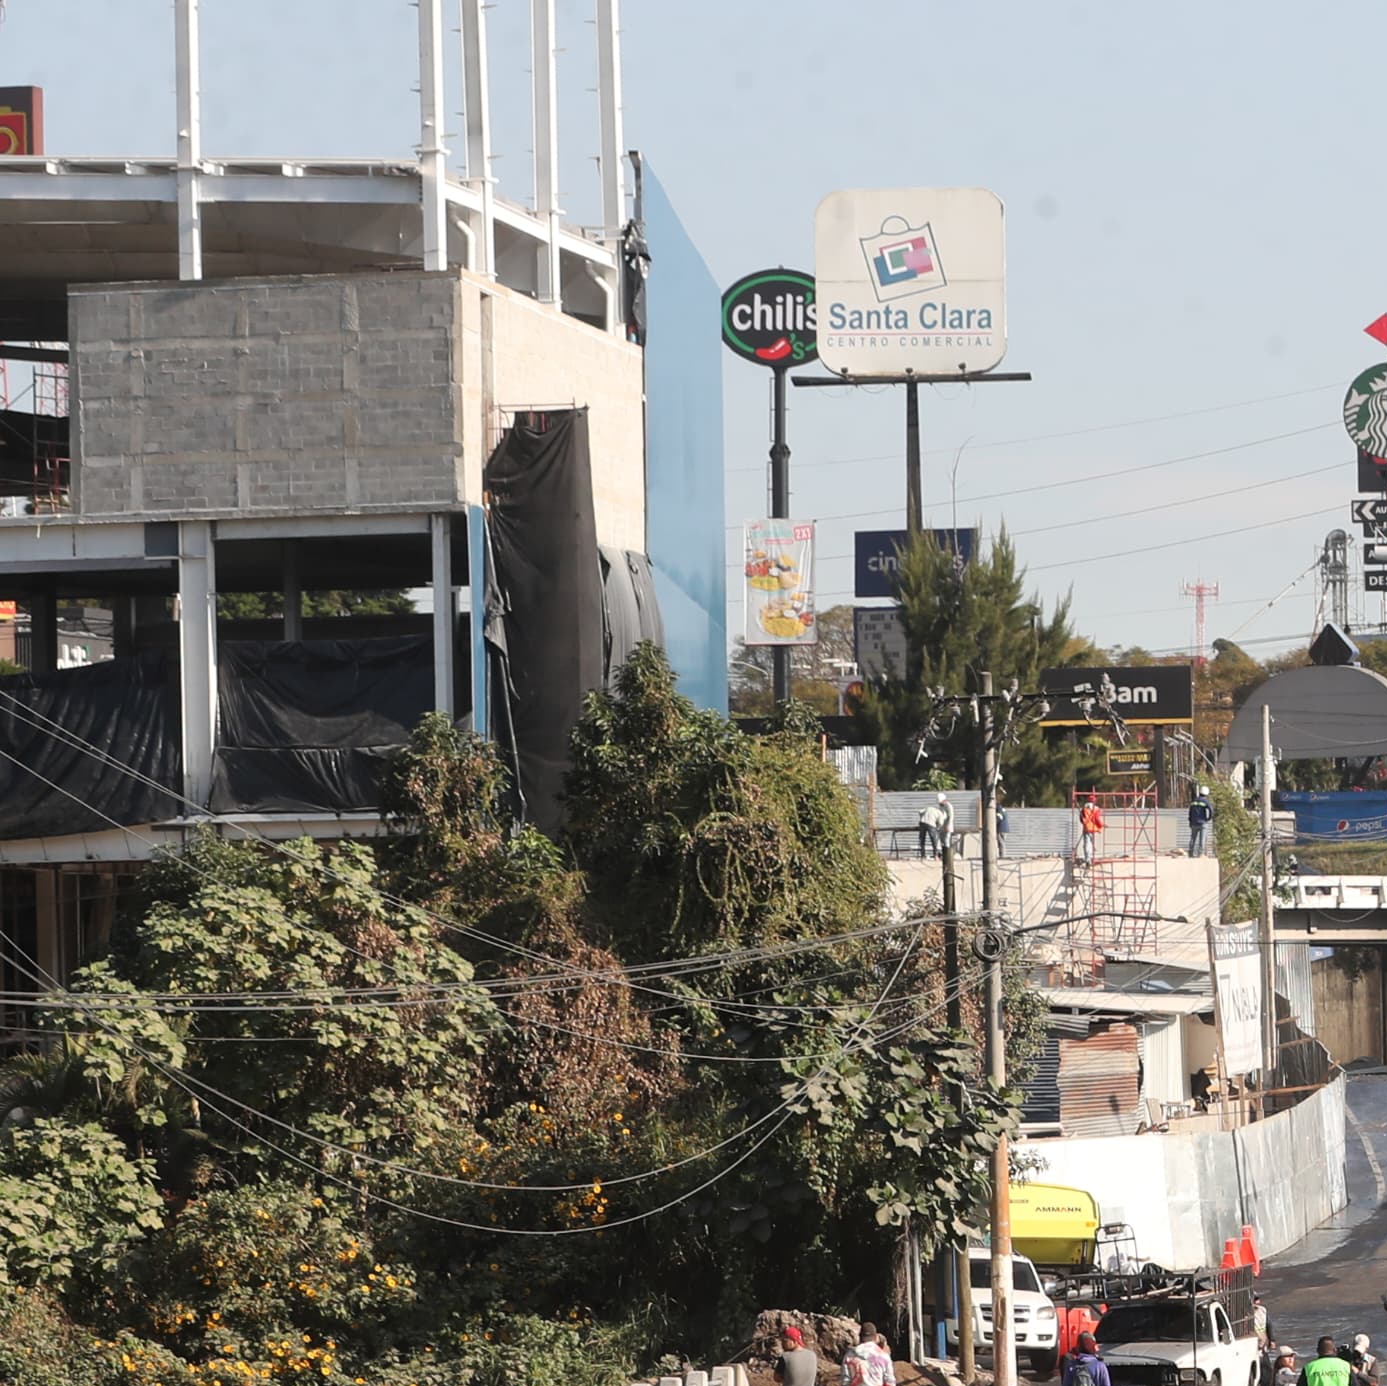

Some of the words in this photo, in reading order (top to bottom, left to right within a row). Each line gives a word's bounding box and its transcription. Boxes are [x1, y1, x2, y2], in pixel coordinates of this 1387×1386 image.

[829, 303, 909, 330] Santa
[919, 303, 992, 330] Clara
[827, 337, 889, 347] CENTRO
[899, 337, 992, 347] COMERCIAL
